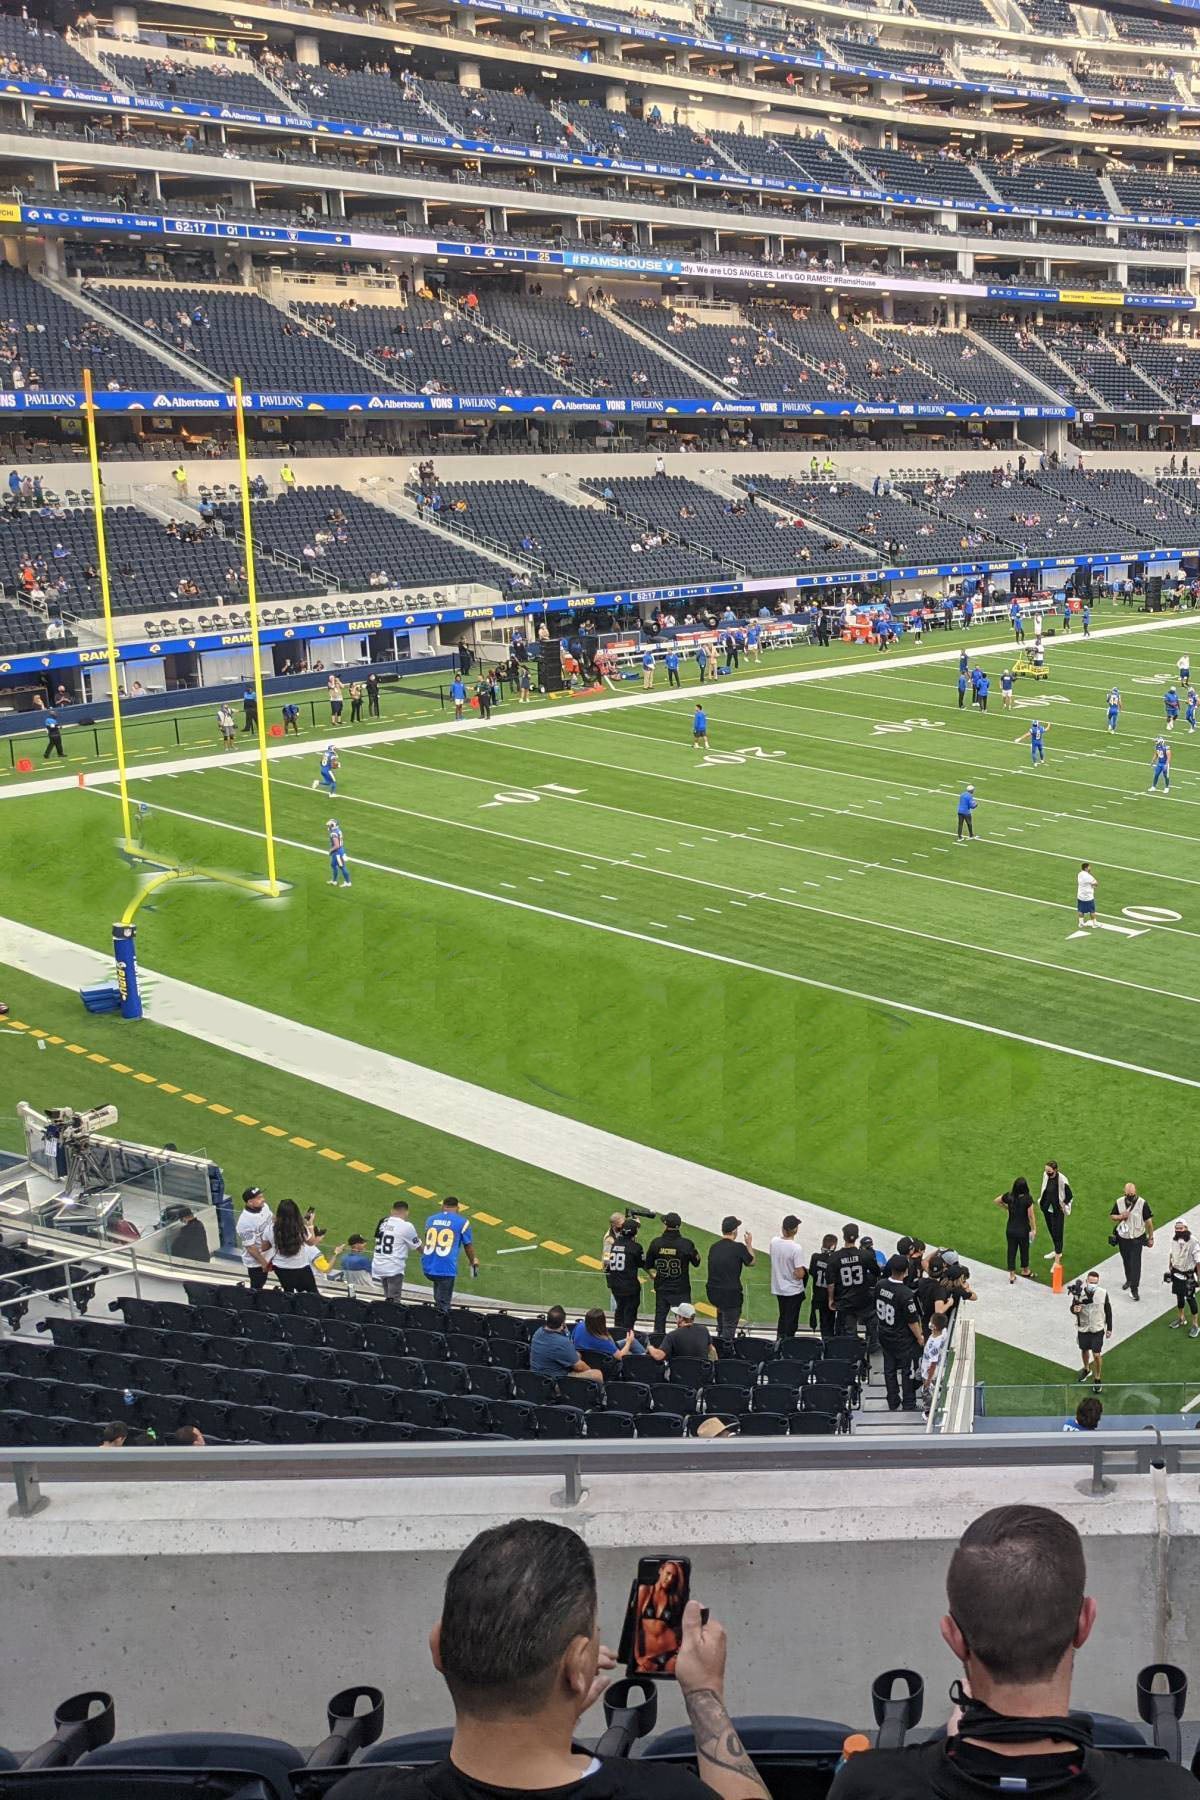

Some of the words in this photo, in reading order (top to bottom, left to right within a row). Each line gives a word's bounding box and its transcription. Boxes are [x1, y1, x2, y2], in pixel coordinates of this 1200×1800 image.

[75, 92, 108, 103] Albertsons
[112, 94, 131, 105] VONS
[135, 97, 165, 109] PAVILIONS
[81, 215, 117, 224] SEPTEMBER
[175, 221, 207, 233] 62:17
[226, 226, 238, 235] Q1
[572, 253, 663, 270] #RAMSHOUSE
[697, 265, 709, 274] We
[723, 267, 738, 276] LOS
[739, 268, 775, 279] ANGELES.
[776, 271, 793, 281] Let's
[794, 272, 806, 281] GO
[833, 276, 877, 287] #RamsHouse
[24, 394, 76, 407] PAVILIONS
[172, 396, 220, 408] Albertsons
[259, 395, 304, 407] PAVILIONS
[384, 398, 425, 409] Albertsons
[430, 397, 453, 409] VONS
[459, 396, 497, 410] PAVILIONS
[565, 401, 601, 411] Albertsons
[606, 400, 626, 411] VONS
[631, 399, 664, 411] PAVILIONS
[724, 403, 756, 413] Albertsons
[760, 401, 778, 412] VONS
[782, 401, 811, 414] PAVILIONS
[865, 405, 894, 414] Albertsons
[898, 404, 914, 415] VONS
[918, 404, 945, 415] PAVILIONS
[993, 407, 1021, 416] Albertsons
[1023, 406, 1039, 416] VONS
[1042, 406, 1066, 417] PAVILIONS
[1083, 413, 1094, 421] CC
[568, 597, 596, 607] RAMS
[464, 607, 494, 618] RAMS
[349, 619, 382, 630] RAMS
[704, 745, 787, 766] 20
[375, 1234, 395, 1255] 28
[424, 1227, 454, 1257] 99
[609, 1252, 626, 1271] 28
[656, 1258, 682, 1278] 28
[840, 1265, 864, 1287] 83
[876, 1300, 895, 1325] 98
